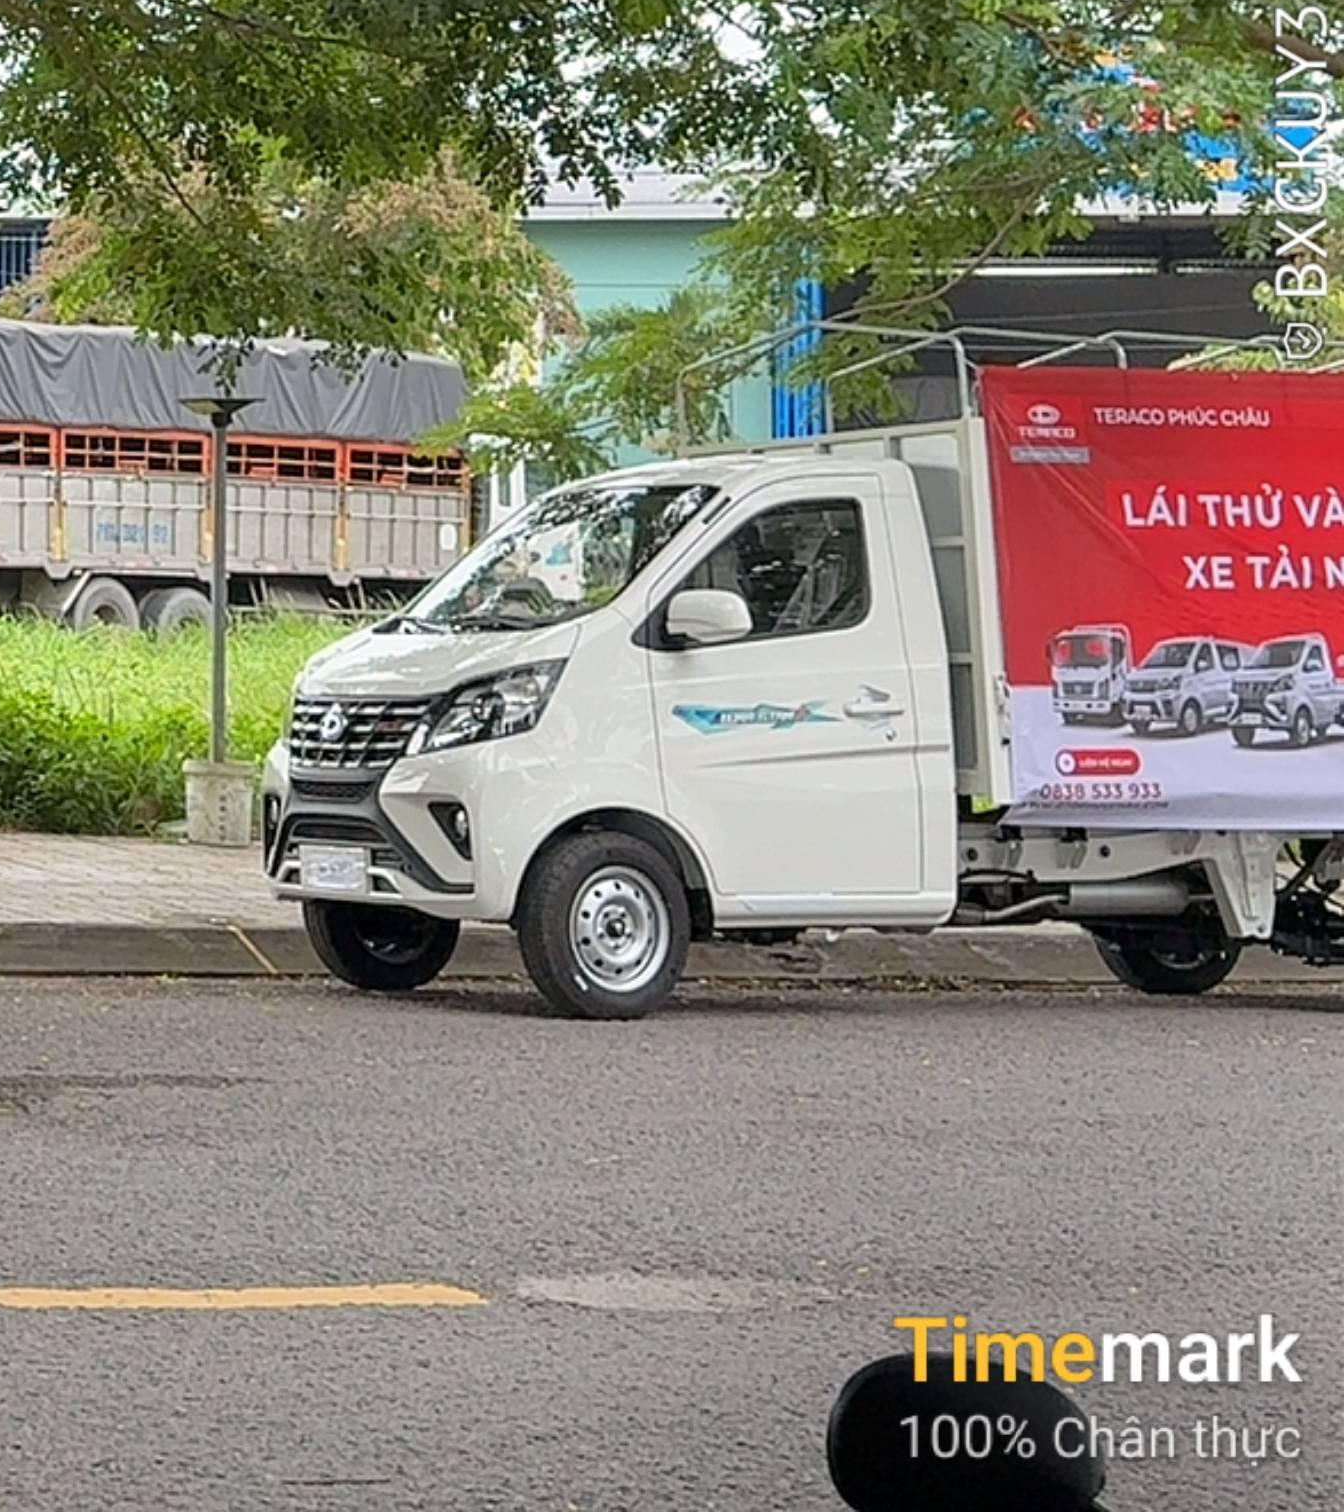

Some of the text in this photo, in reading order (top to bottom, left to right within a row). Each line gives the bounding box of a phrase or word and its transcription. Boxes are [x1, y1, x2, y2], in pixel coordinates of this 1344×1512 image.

[1093, 405, 1271, 428] TERACO PHÚC CHÂU
[1120, 482, 1344, 529] LÁI THỬ VÀ
[1181, 555, 1235, 590] XE
[1245, 543, 1313, 590] TẢI
[1039, 782, 1162, 800] 0838 533 933
